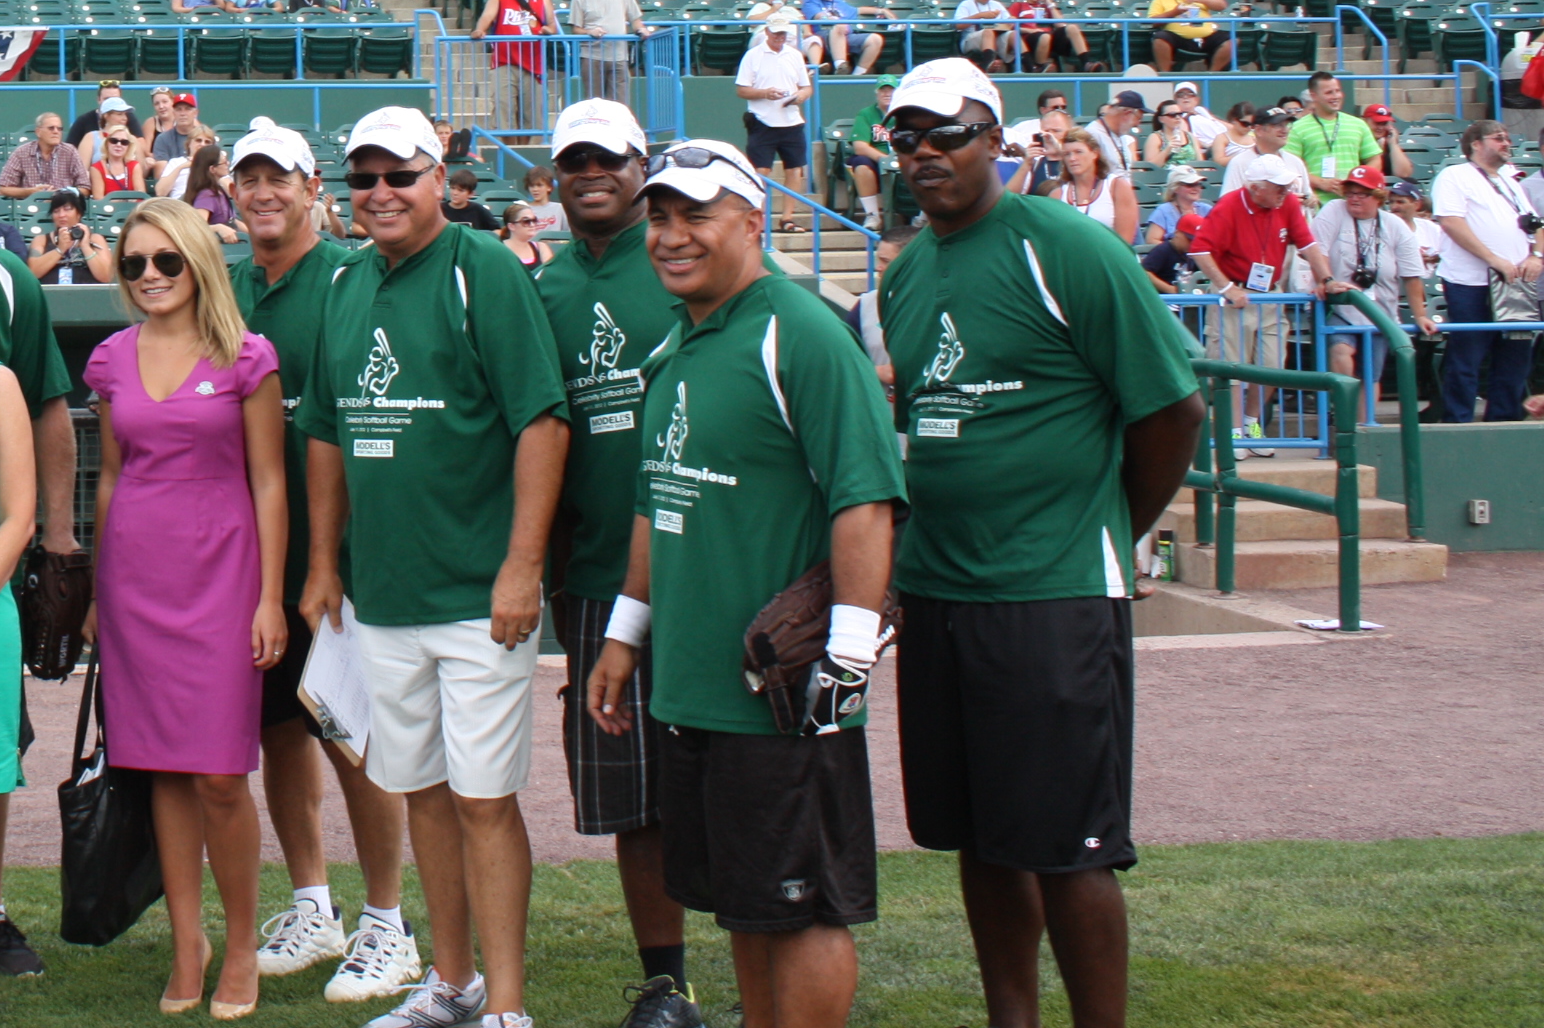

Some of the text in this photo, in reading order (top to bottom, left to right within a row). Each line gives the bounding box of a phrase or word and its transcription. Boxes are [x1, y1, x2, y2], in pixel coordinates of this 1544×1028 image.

[373, 397, 445, 410] Champions
[389, 417, 412, 425] Game
[592, 413, 630, 427] MODELL'S
